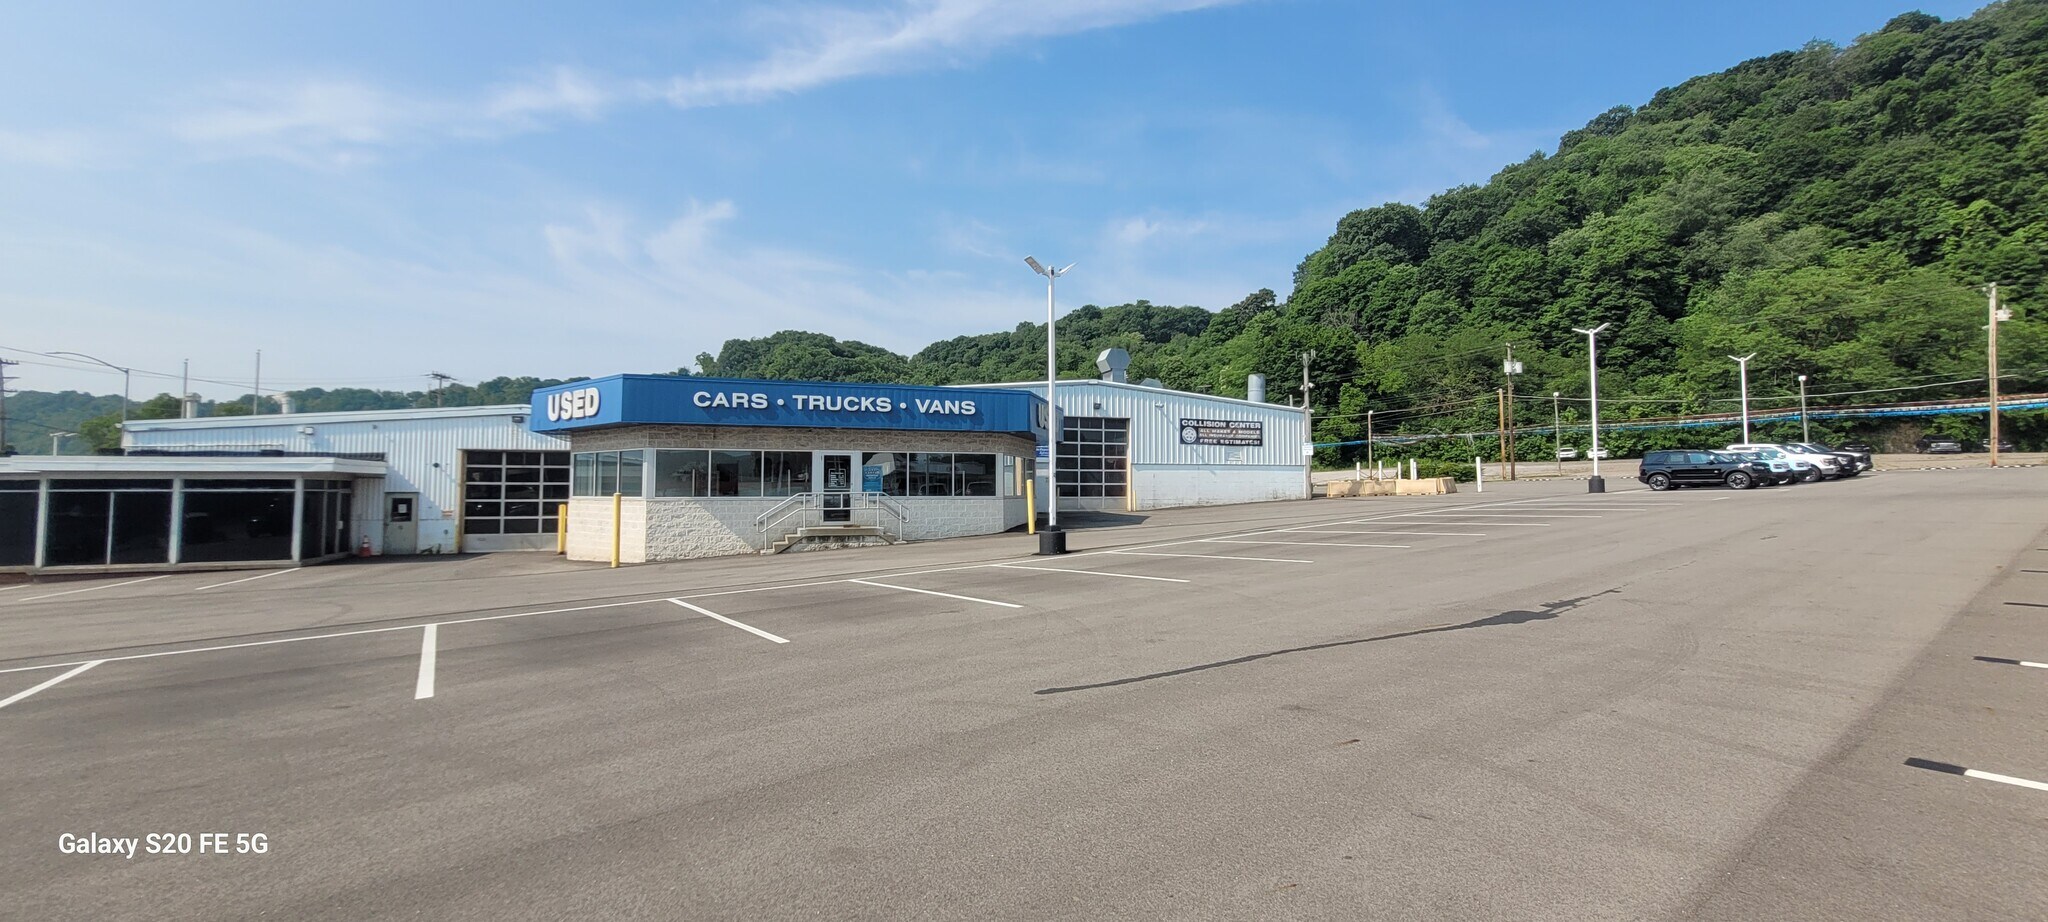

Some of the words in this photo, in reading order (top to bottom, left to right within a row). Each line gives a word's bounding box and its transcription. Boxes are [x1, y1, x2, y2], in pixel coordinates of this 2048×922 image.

[547, 387, 600, 421] USED
[693, 391, 768, 409] CARS
[792, 395, 892, 412] TRUCKS
[915, 399, 976, 415] VANS
